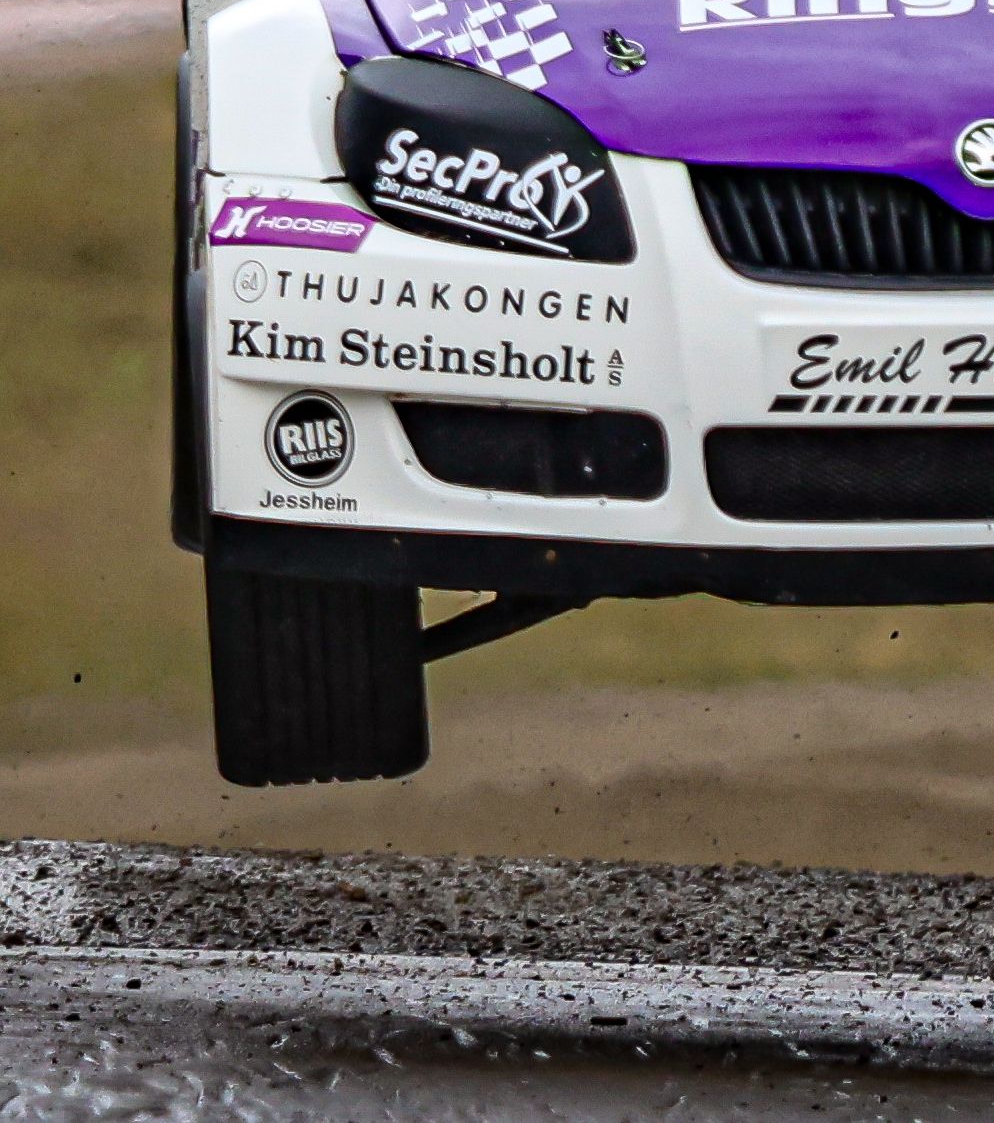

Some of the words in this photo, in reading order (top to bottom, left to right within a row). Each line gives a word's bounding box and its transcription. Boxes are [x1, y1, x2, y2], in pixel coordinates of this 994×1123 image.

[375, 129, 544, 211] SecPro
[256, 216, 365, 237] HOOSIER
[277, 269, 629, 324] THUJAKONGEN
[227, 319, 326, 363] Kim
[340, 328, 595, 385] Steinsholt
[790, 333, 927, 390] Emil
[279, 418, 343, 455] RIIS
[259, 489, 358, 512] Jessheim
